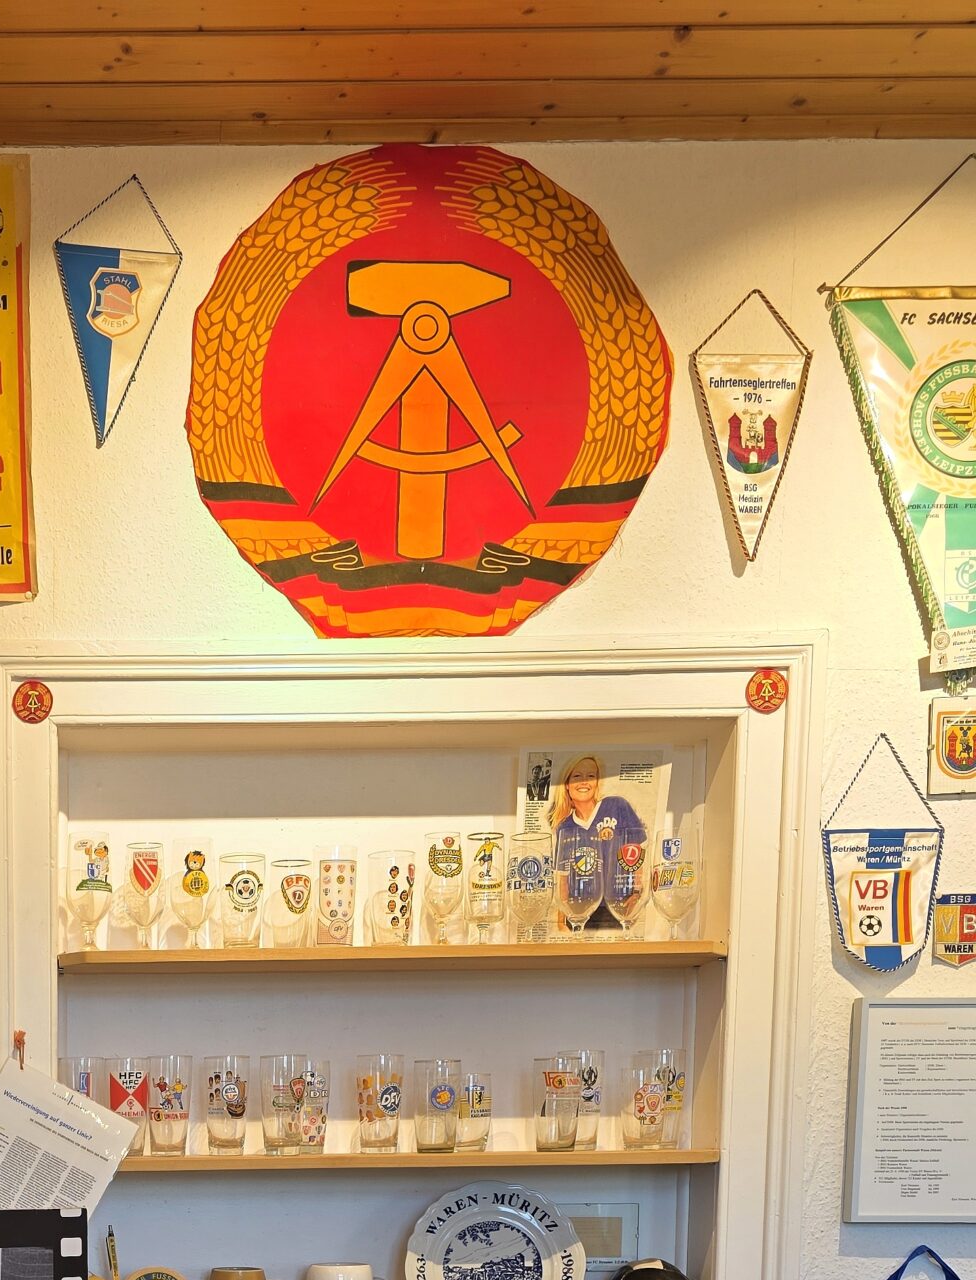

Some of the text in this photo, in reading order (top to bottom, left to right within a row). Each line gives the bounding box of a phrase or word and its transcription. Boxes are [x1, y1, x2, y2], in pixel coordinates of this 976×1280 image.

[103, 274, 133, 291] STAHL
[101, 317, 129, 329] RIESA
[900, 312, 917, 325] FC
[708, 375, 797, 393] Fahrtenseglertreffen
[742, 392, 763, 405] 1976
[743, 483, 758, 493] BSG
[738, 493, 764, 504] Medizin
[738, 504, 763, 514] WAREN
[596, 816, 618, 833] DDR
[832, 842, 938, 854] Betriebssportgemeinschaft
[285, 876, 310, 888] BFC
[854, 879, 889, 900] VB
[950, 895, 972, 904] BSG
[858, 904, 885, 912] Waren
[944, 942, 974, 954] WAREN
[119, 1071, 142, 1079] HFC
[3, 1088, 93, 1141] Wiedervereinigung auf ganzer Linie?
[425, 1191, 560, 1236] WAREN MÜRITZ
